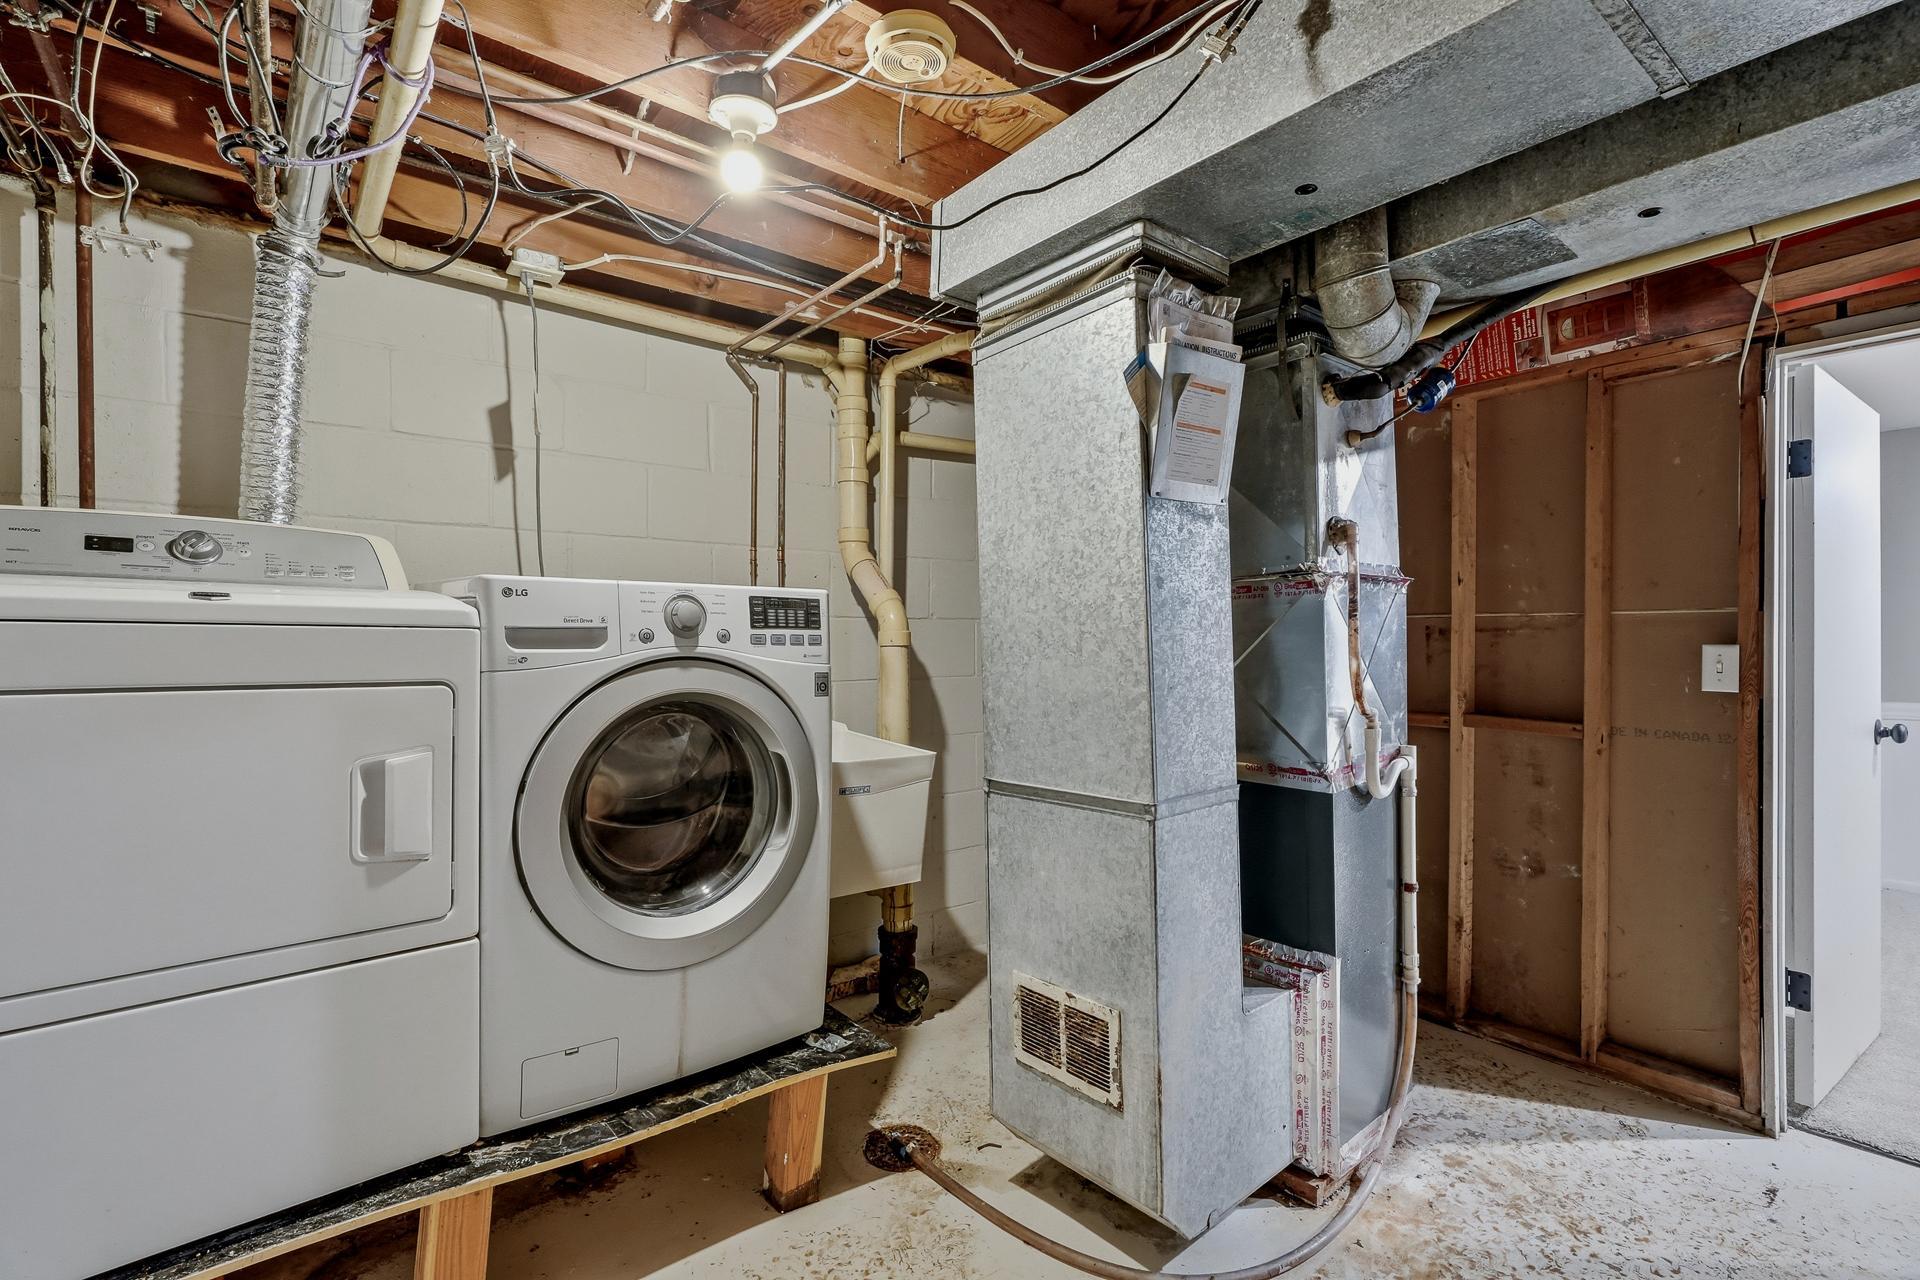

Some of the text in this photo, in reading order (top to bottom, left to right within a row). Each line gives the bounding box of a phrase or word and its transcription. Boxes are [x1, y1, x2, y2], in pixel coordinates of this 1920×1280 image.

[515, 588, 529, 597] LG
[1634, 728, 1648, 737] IN
[1654, 729, 1711, 743] CANADA
